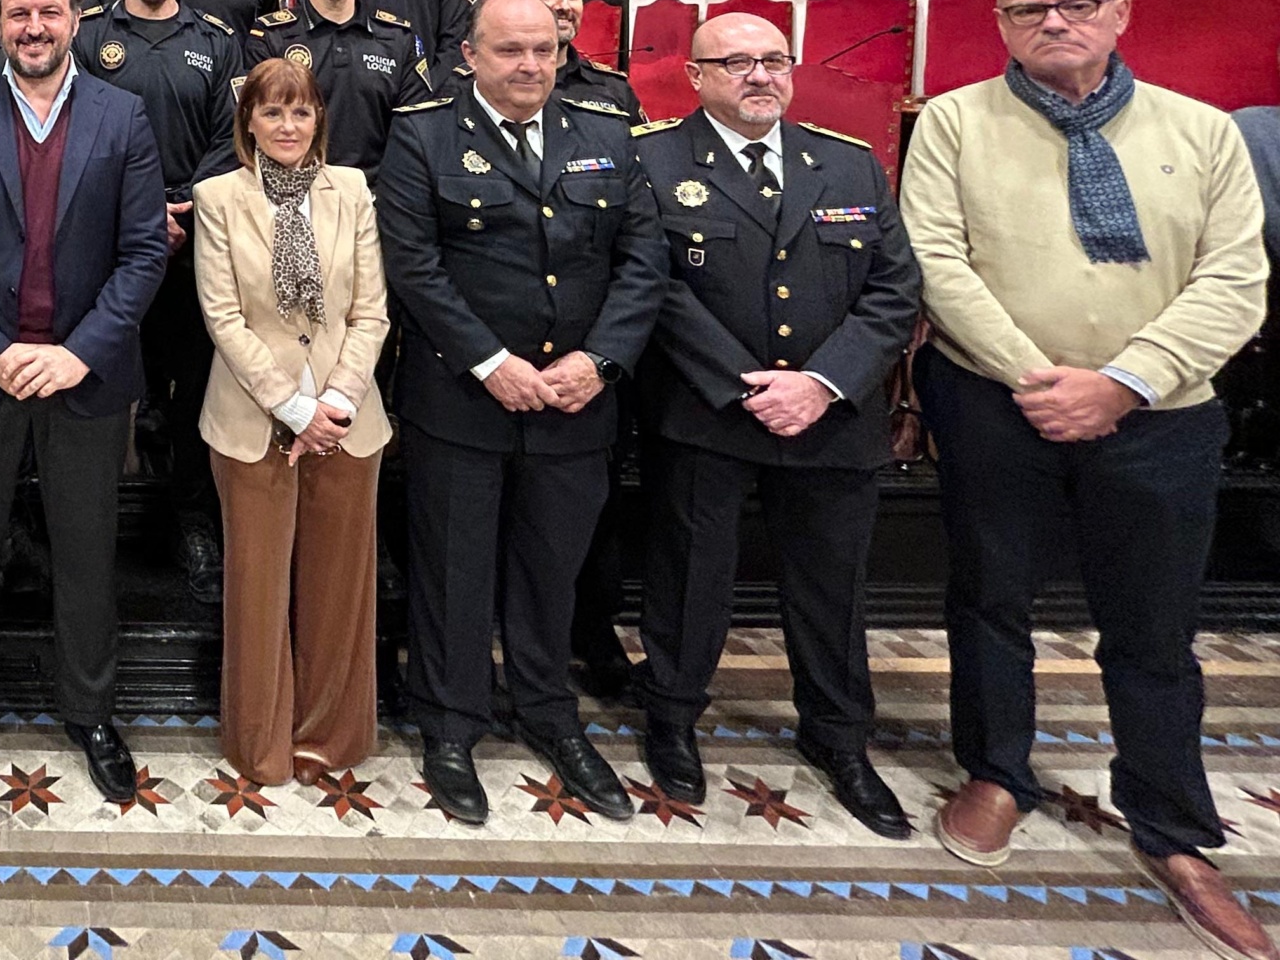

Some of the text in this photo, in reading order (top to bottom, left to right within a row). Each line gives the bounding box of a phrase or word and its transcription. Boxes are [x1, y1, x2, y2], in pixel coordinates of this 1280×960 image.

[186, 57, 213, 73] LOCAL
[362, 54, 397, 68] POLICIA
[366, 61, 393, 75] LOCAL
